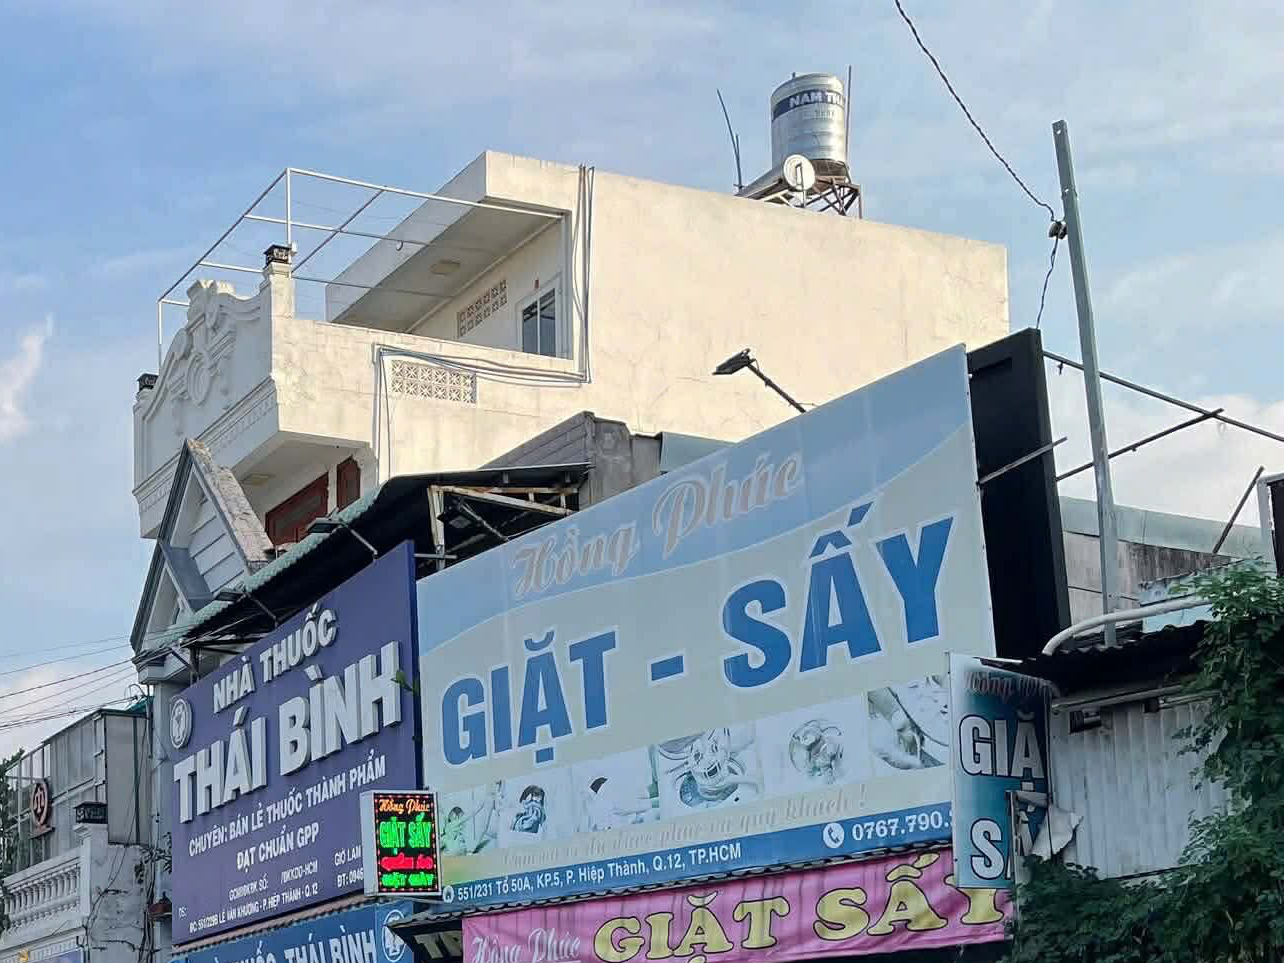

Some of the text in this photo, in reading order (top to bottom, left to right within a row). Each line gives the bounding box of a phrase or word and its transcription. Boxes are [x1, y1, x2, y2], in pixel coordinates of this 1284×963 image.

[513, 451, 803, 593] Hồng Phúc
[213, 603, 338, 714] NHÀ THUỐC
[442, 628, 617, 766] GIẶT
[721, 502, 954, 689] SẤY
[174, 641, 402, 824] THÁI BÌNH
[959, 709, 1045, 791] GIẶ
[189, 750, 386, 857] CHUYÊN: BÁN LẺ THUỐC THÀNH PHẨM
[236, 822, 319, 873] ĐẠT CHUẨN GPP
[852, 811, 952, 842] 0767.790.
[349, 871, 364, 885] 0946
[458, 884, 493, 900] 551/231
[496, 880, 509, 895] Tổ
[512, 877, 534, 893] 50A,
[537, 873, 564, 889] KP.5,
[578, 867, 605, 886] Hiệp
[608, 861, 650, 878] Thành,
[652, 855, 686, 873] Q.12,
[688, 843, 742, 865] TP.HCM
